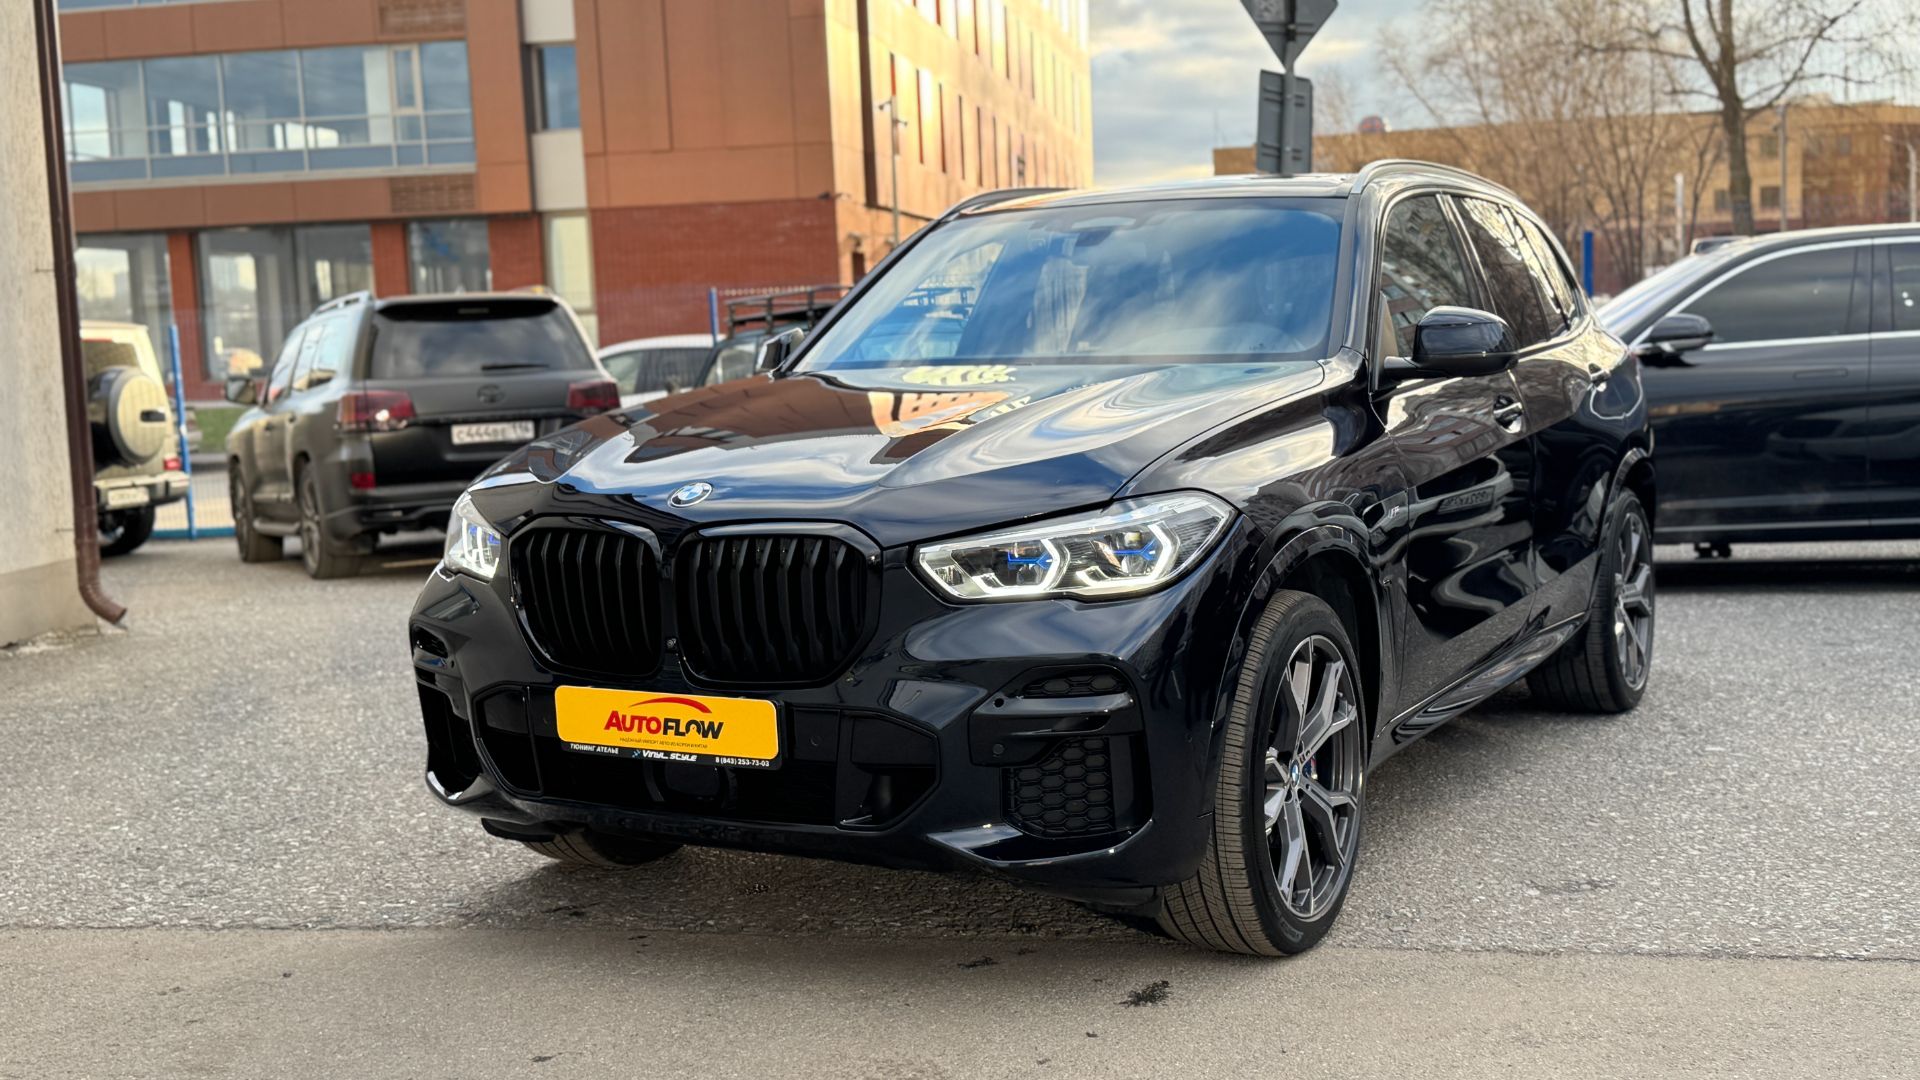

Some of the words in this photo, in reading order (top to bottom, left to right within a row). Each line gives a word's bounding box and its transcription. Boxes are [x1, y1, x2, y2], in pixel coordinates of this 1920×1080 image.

[604, 710, 724, 740] AUTOFLOW
[570, 743, 596, 753] ТЮНИНГ
[596, 745, 619, 755] АТЕЛЬЕ
[720, 757, 737, 765] (843)
[737, 759, 770, 767] 253-73-03
